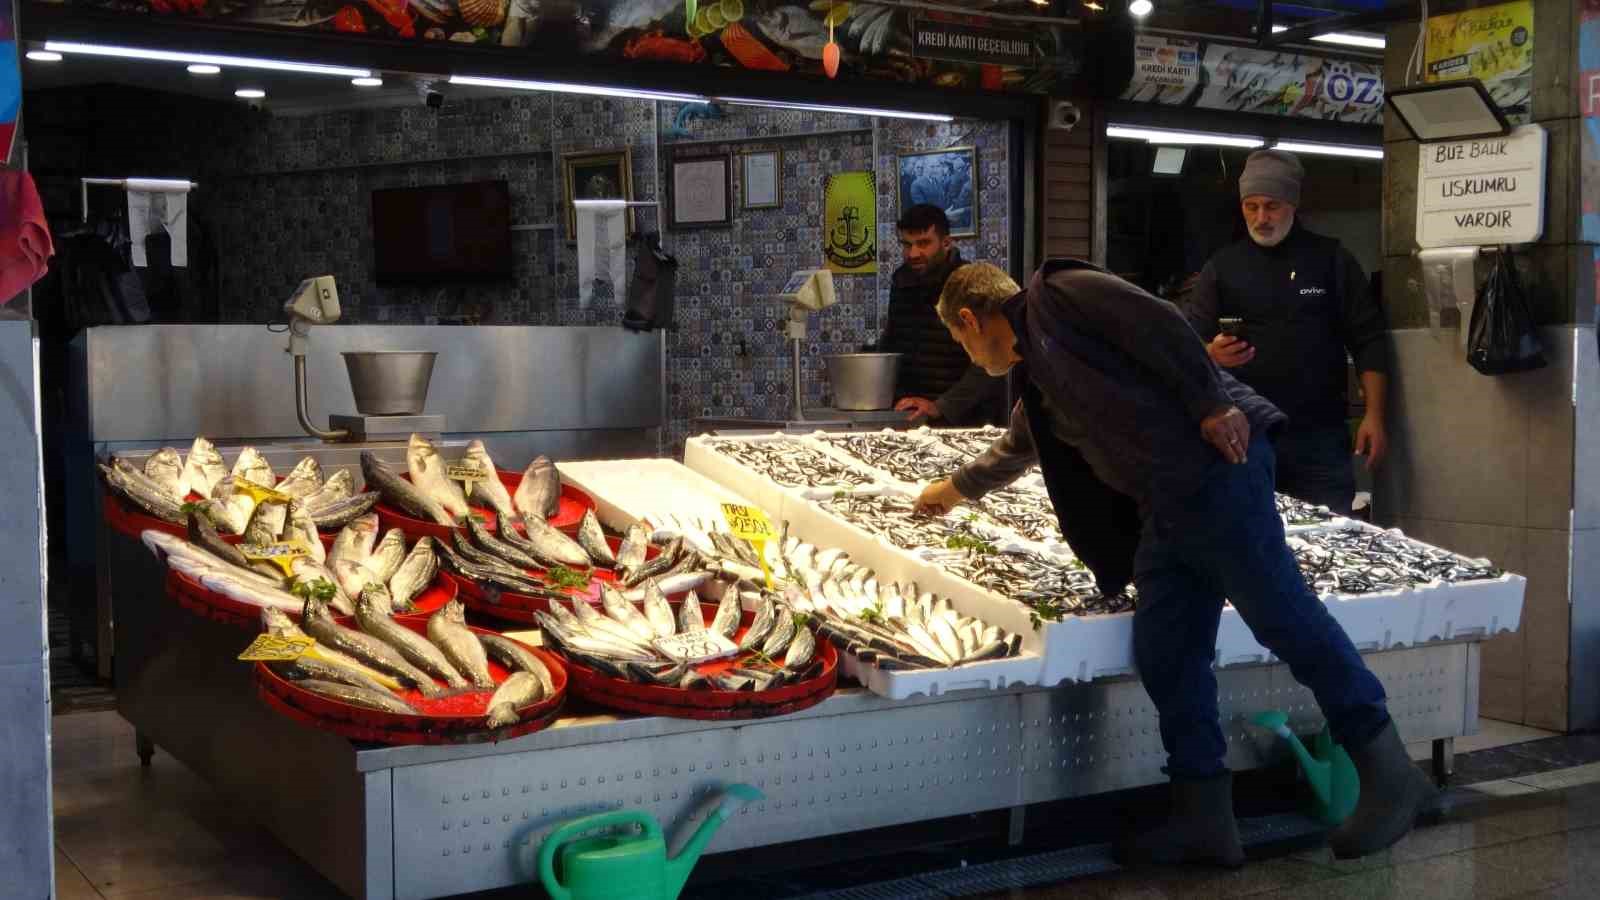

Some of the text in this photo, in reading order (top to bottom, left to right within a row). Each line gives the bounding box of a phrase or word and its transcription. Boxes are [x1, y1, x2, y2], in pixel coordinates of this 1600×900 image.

[948, 33, 976, 49] KARTI
[1435, 140, 1508, 163] BUZ BALIK
[1442, 177, 1517, 197] USKUMRU
[1455, 210, 1512, 228] VARDIR
